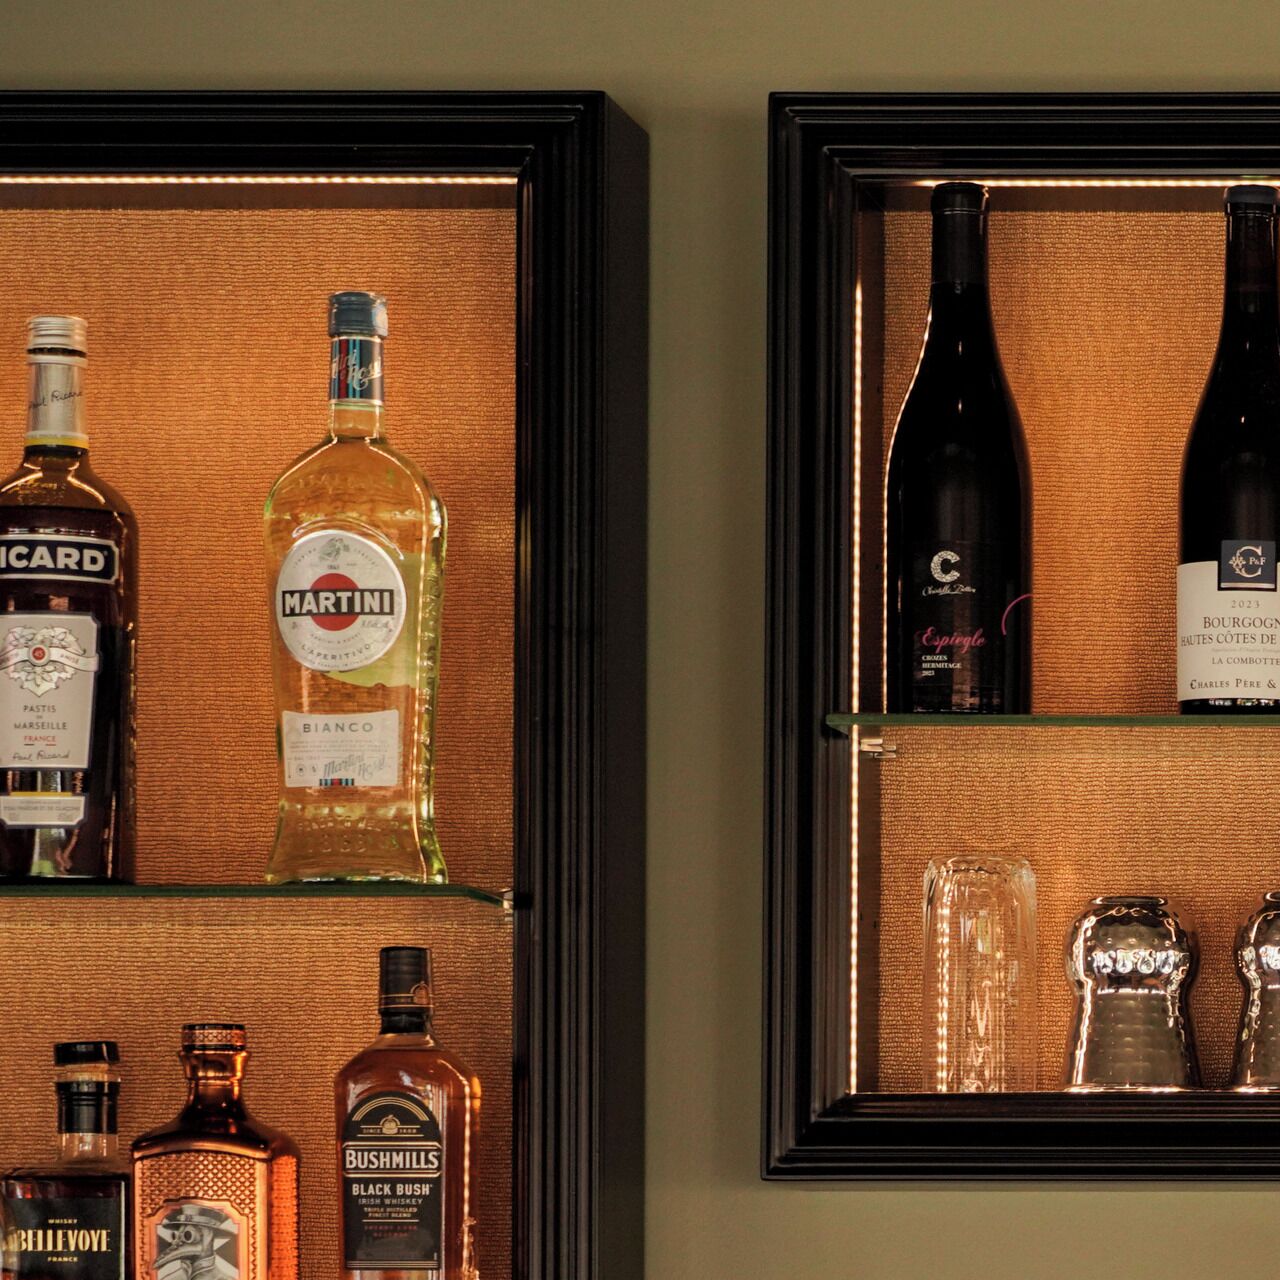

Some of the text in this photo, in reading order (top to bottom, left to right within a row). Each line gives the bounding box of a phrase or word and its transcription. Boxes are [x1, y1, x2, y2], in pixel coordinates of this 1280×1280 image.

[0, 546, 105, 572] ICARD
[930, 550, 961, 583] C
[284, 591, 391, 615] MARTINI
[1181, 634, 1213, 648] HAUTES
[1216, 630, 1257, 645] CÔTES
[1261, 633, 1277, 645] DE
[1212, 656, 1280, 666] LA COMBOTTE
[1190, 678, 1230, 690] CHARLES
[1235, 678, 1261, 689] PÈRE
[1267, 680, 1277, 689] &
[23, 704, 57, 713] PASTIS
[14, 722, 68, 730] MARSEILLE
[303, 722, 374, 734] BIANCO
[24, 735, 57, 743] FRANCE
[345, 1149, 439, 1169] BUSHMILLS
[352, 1183, 430, 1196] BLACK BUSH
[17, 1229, 112, 1252] BELLEVOYE
